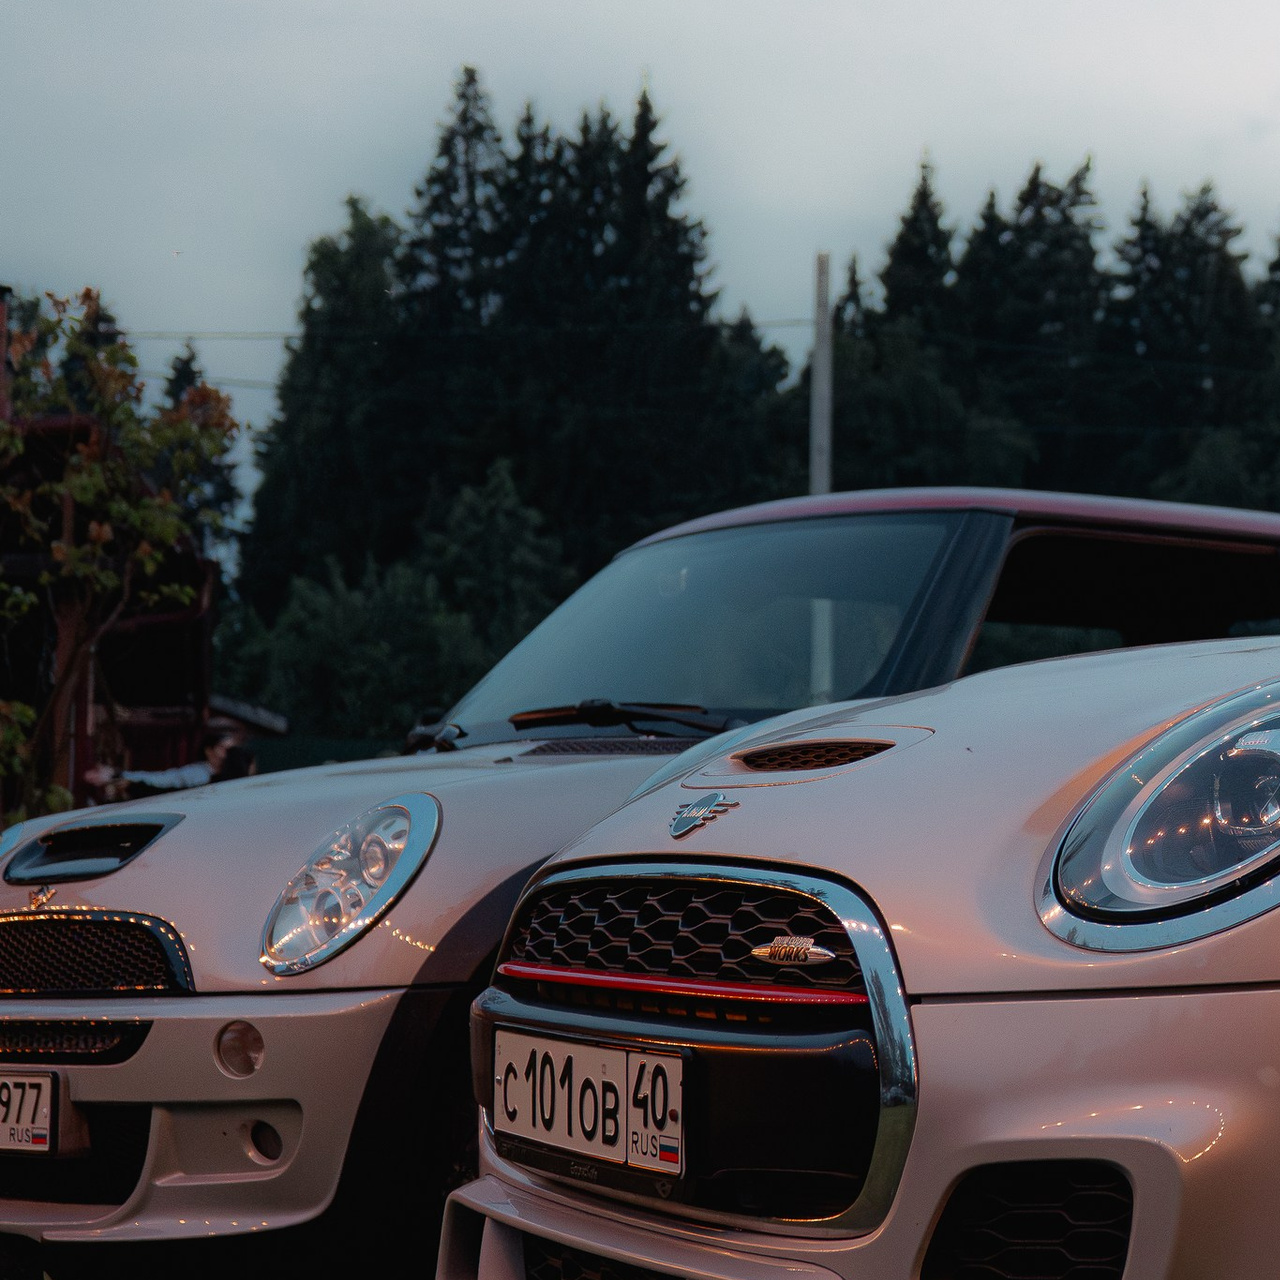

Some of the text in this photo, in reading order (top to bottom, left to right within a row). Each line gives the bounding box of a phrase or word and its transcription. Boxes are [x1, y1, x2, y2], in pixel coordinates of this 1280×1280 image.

[769, 945, 809, 962] WORKS
[0, 1082, 42, 1124] 977
[632, 1060, 668, 1130] 40
[9, 1127, 31, 1143] RUS
[631, 1131, 658, 1158] RUS
